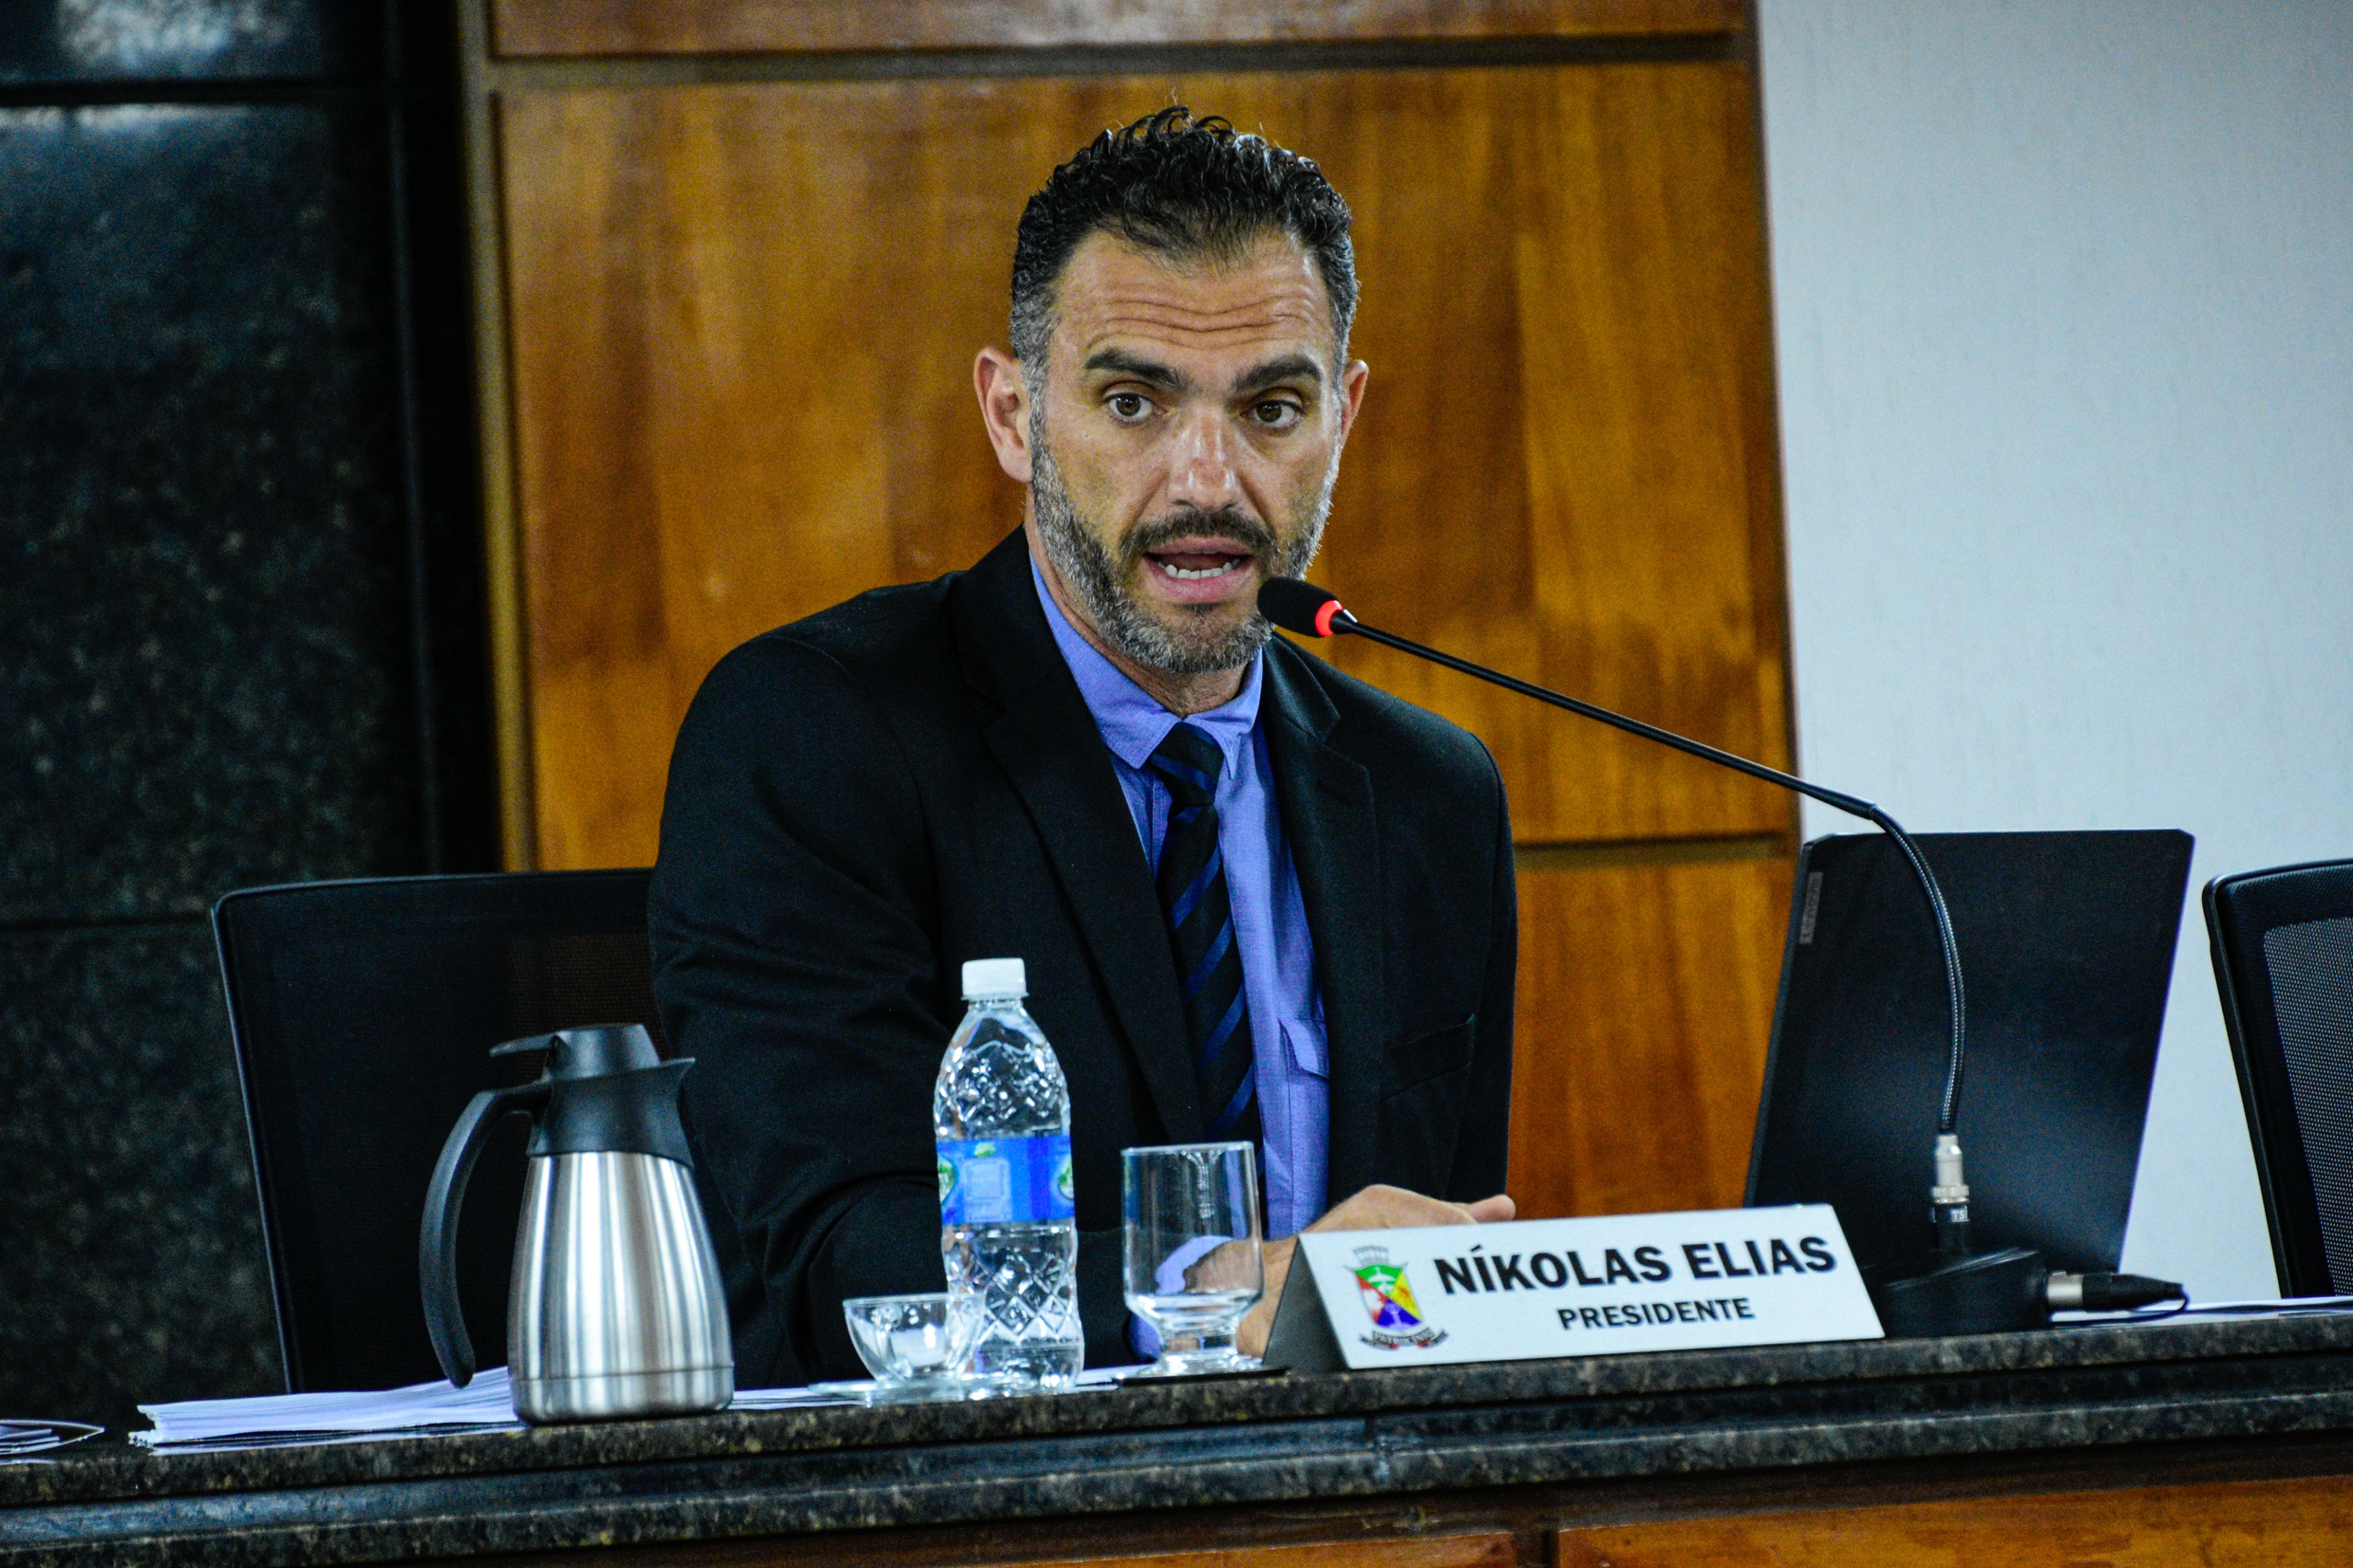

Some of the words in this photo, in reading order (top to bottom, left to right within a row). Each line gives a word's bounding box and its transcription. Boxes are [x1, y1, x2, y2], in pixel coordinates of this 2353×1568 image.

[1435, 1244, 1671, 1293] NÍKOLAS
[1682, 1237, 1836, 1279] ELIAS
[1558, 1299, 1754, 1329] PRESIDENTE
